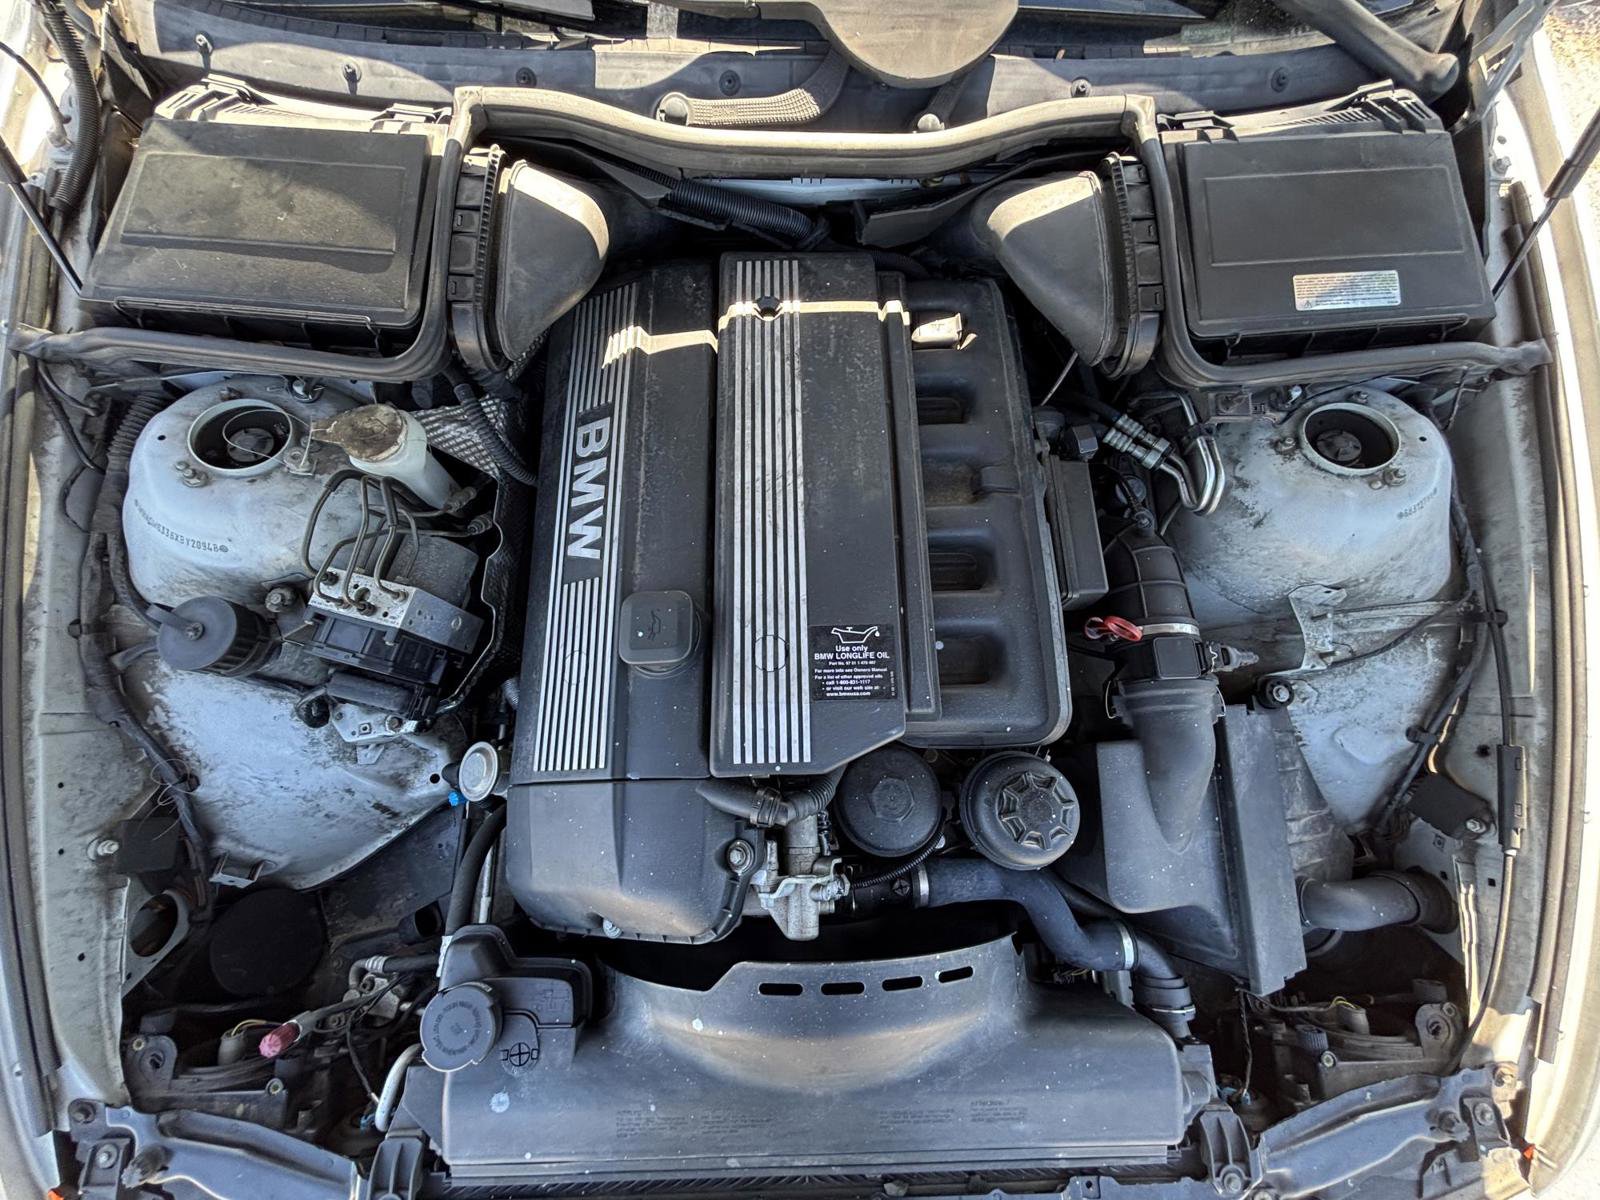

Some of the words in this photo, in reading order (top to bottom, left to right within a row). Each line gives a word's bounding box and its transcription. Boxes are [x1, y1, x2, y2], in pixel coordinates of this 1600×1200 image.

[567, 416, 611, 559] BMW
[852, 644, 869, 653] only
[836, 652, 875, 660] LONGLIFE
[876, 651, 891, 659] OIL
